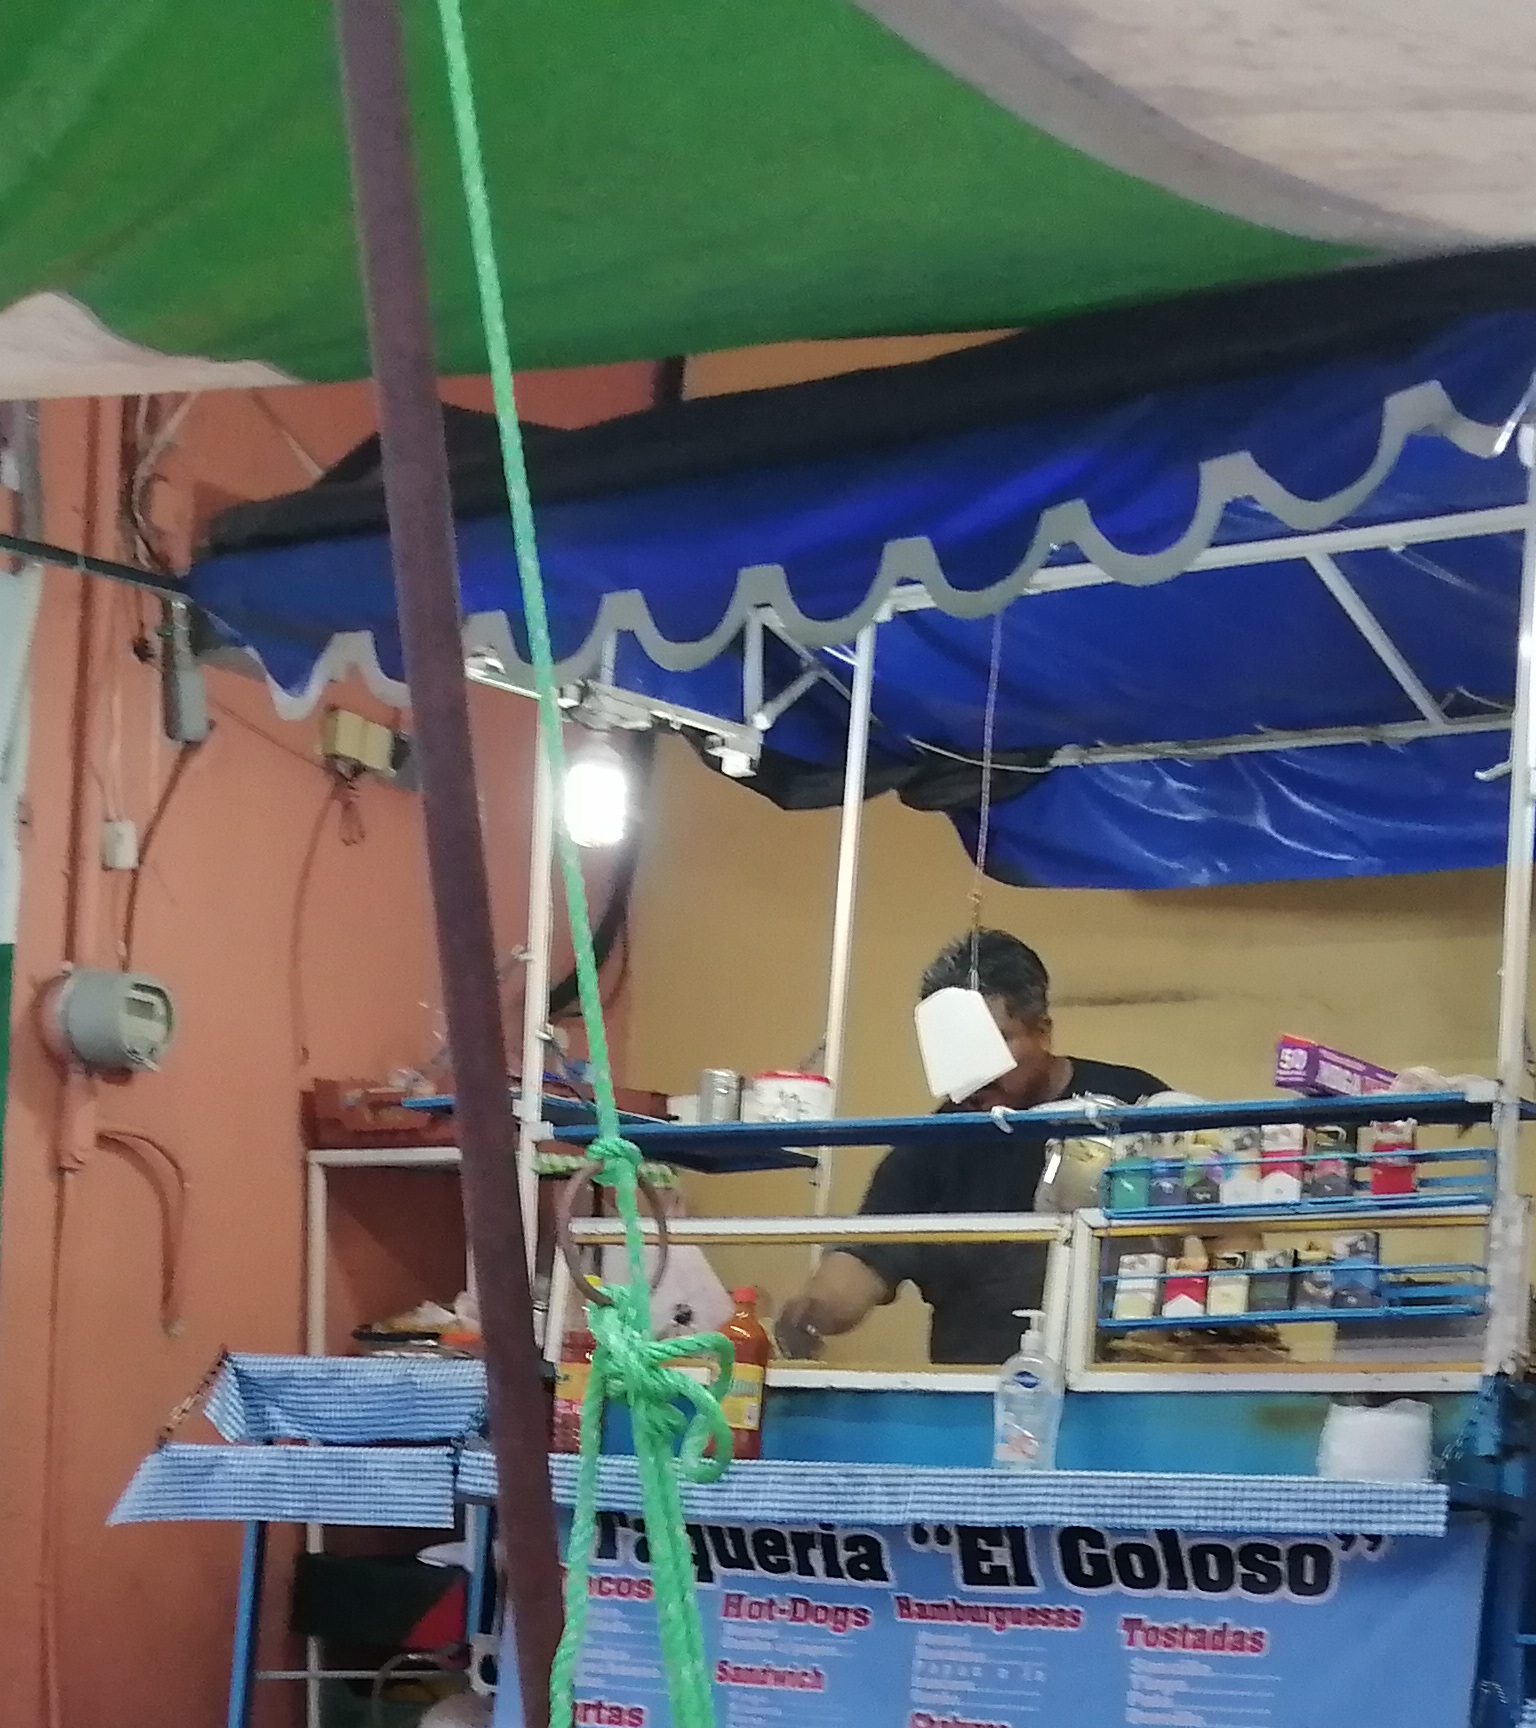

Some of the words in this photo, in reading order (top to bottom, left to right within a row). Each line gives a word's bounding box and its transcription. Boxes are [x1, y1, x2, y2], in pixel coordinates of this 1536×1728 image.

[720, 1593, 872, 1633] Hot-Dogs
[894, 1594, 1083, 1633] Hamburguesas
[1121, 1616, 1265, 1653] Tostadas
[715, 1659, 826, 1692] Sandwich
